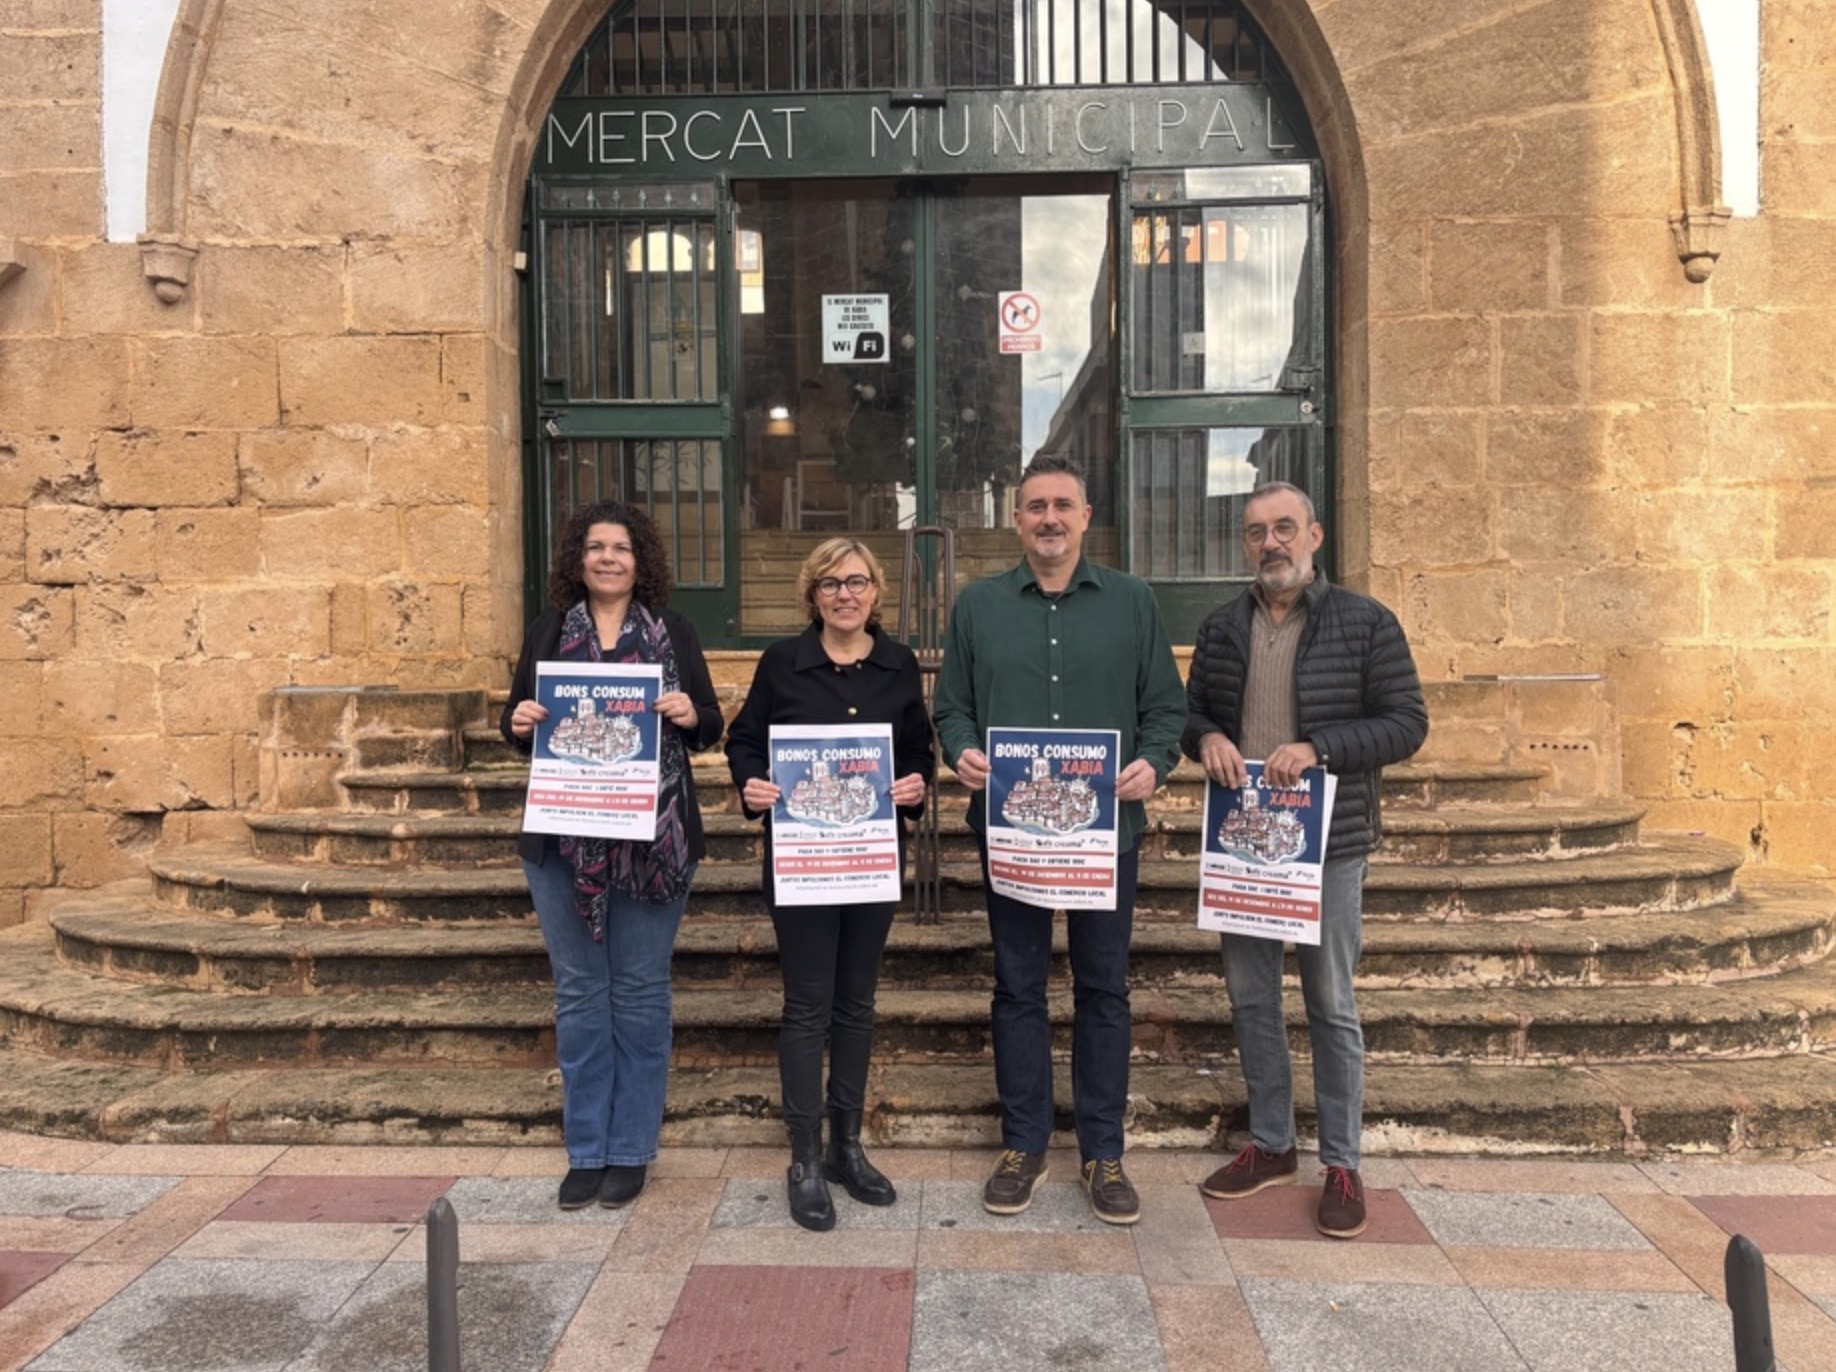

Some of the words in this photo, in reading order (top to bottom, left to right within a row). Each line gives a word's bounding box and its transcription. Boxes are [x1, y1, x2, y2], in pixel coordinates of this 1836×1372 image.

[547, 106, 806, 164] MERCAT
[870, 96, 1296, 158] MUNICIPAL
[832, 340, 851, 352] Wi
[863, 340, 877, 352] Fi
[554, 684, 588, 699] BONS
[591, 685, 645, 699] CONSUM
[777, 749, 818, 762] BONOS
[822, 747, 882, 761] CONSUMO
[994, 743, 1039, 758] BONOS
[1043, 744, 1107, 759] CONSUMO
